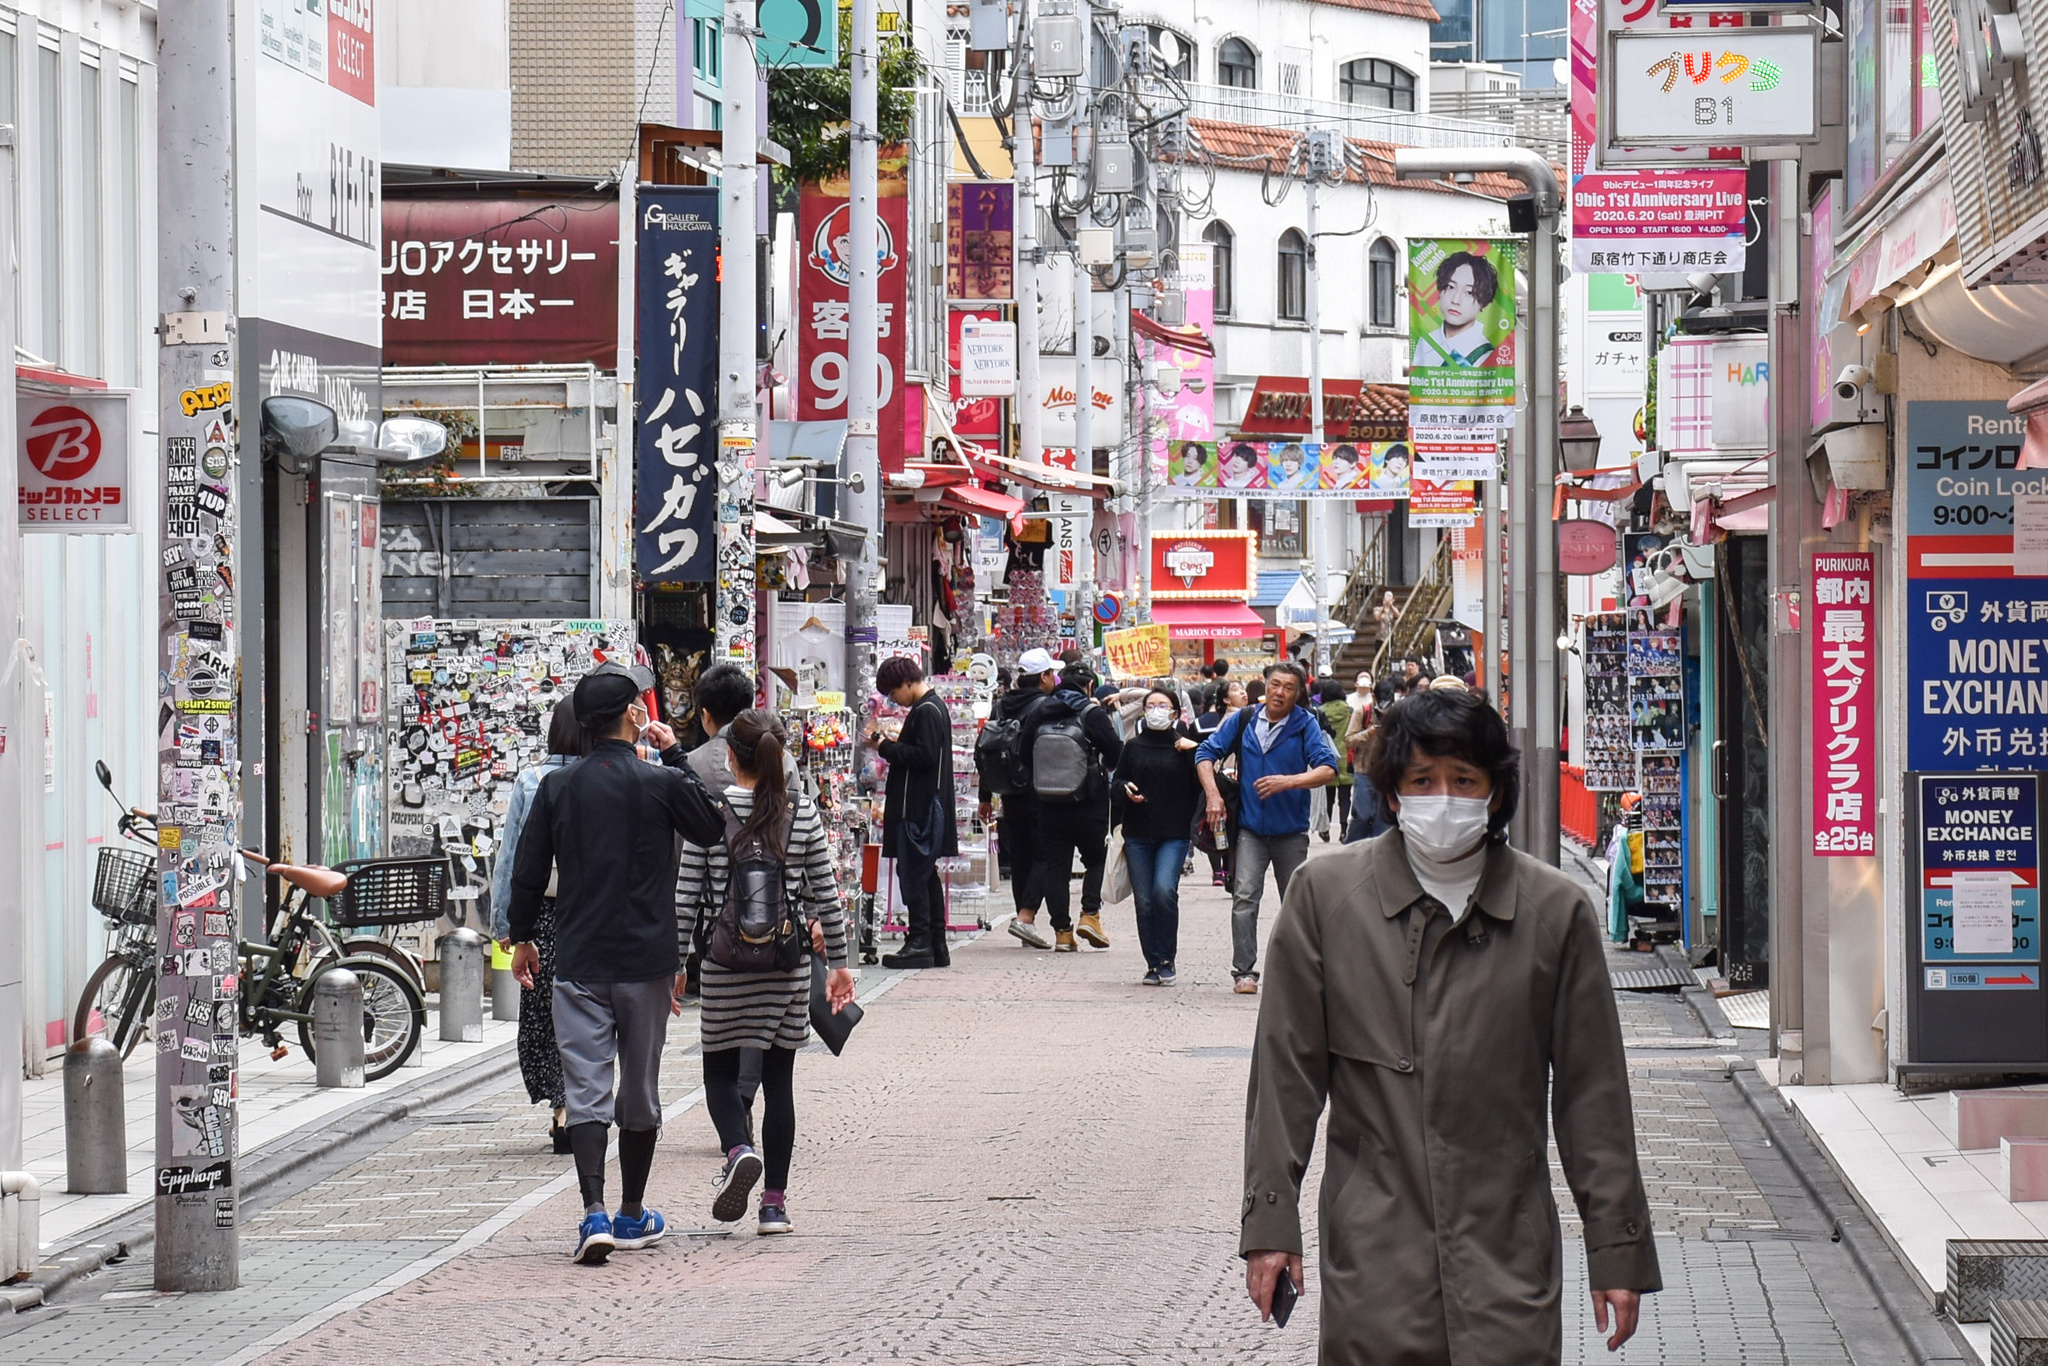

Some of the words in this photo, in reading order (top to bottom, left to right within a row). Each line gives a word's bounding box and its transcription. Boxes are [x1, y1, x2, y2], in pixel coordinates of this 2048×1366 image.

[337, 30, 364, 80] SELECT
[1694, 96, 1733, 125] B1
[1575, 193, 1605, 208] 9bic
[1608, 194, 1630, 207] 1'st
[1632, 192, 1712, 208] Anniversary
[1715, 191, 1743, 206] Live
[667, 213, 699, 222] GALLERY
[1593, 211, 1655, 221] 2020.6.20
[1657, 210, 1682, 222] (sat)
[1684, 210, 1725, 221] 豊洲PIT
[667, 223, 712, 231] HASEGAWA
[1614, 226, 1636, 234] 15:00
[1642, 226, 1668, 234] START
[1671, 226, 1692, 234] 16:00
[1411, 241, 1439, 268] Kunugi
[1590, 251, 1728, 266] 原宿竹下通り商店会
[1418, 249, 1447, 276] Minato
[382, 290, 426, 320] 店
[463, 289, 574, 320] 日本一
[664, 248, 698, 376] ギャラリー
[967, 344, 1004, 356] NEWYORK
[973, 358, 1010, 371] NEWYORK
[1595, 351, 1640, 366] ガチャ
[292, 354, 319, 394] CAMERA
[1446, 377, 1495, 388] Anniversary
[1497, 377, 1514, 386] Live
[1421, 388, 1460, 396] 2020.6.20
[1420, 414, 1505, 423] 原宿竹下通り商店会
[742, 423, 749, 431] 2
[864, 422, 871, 431] 3
[1346, 426, 1401, 440] BODY
[168, 438, 195, 448] UNCLE
[168, 466, 195, 482] FACE
[641, 387, 710, 576] ハセガワ
[168, 486, 195, 496] PRAZE
[1937, 477, 1990, 496] Coin
[198, 490, 226, 513] 1UP
[27, 508, 101, 520] SELECT
[168, 504, 200, 520] MOZ
[981, 557, 999, 566] あり
[1815, 558, 1870, 572] PURIKURA
[171, 569, 188, 580] DIET
[170, 577, 195, 591] THYME
[1816, 577, 1870, 604] 都内
[1175, 629, 1209, 637] MARION
[1949, 639, 2048, 674] MONE
[197, 651, 230, 681] ARK
[1962, 787, 2020, 801] 外貨両替
[1945, 810, 2013, 825] MONEY
[1815, 826, 1874, 851] 全25台
[1927, 826, 2033, 841] EXCHANGE
[1995, 849, 2017, 862] 환전
[178, 877, 213, 902] POSSIBLE
[187, 1002, 212, 1022] UGS
[159, 1168, 223, 1194] Epiphone
